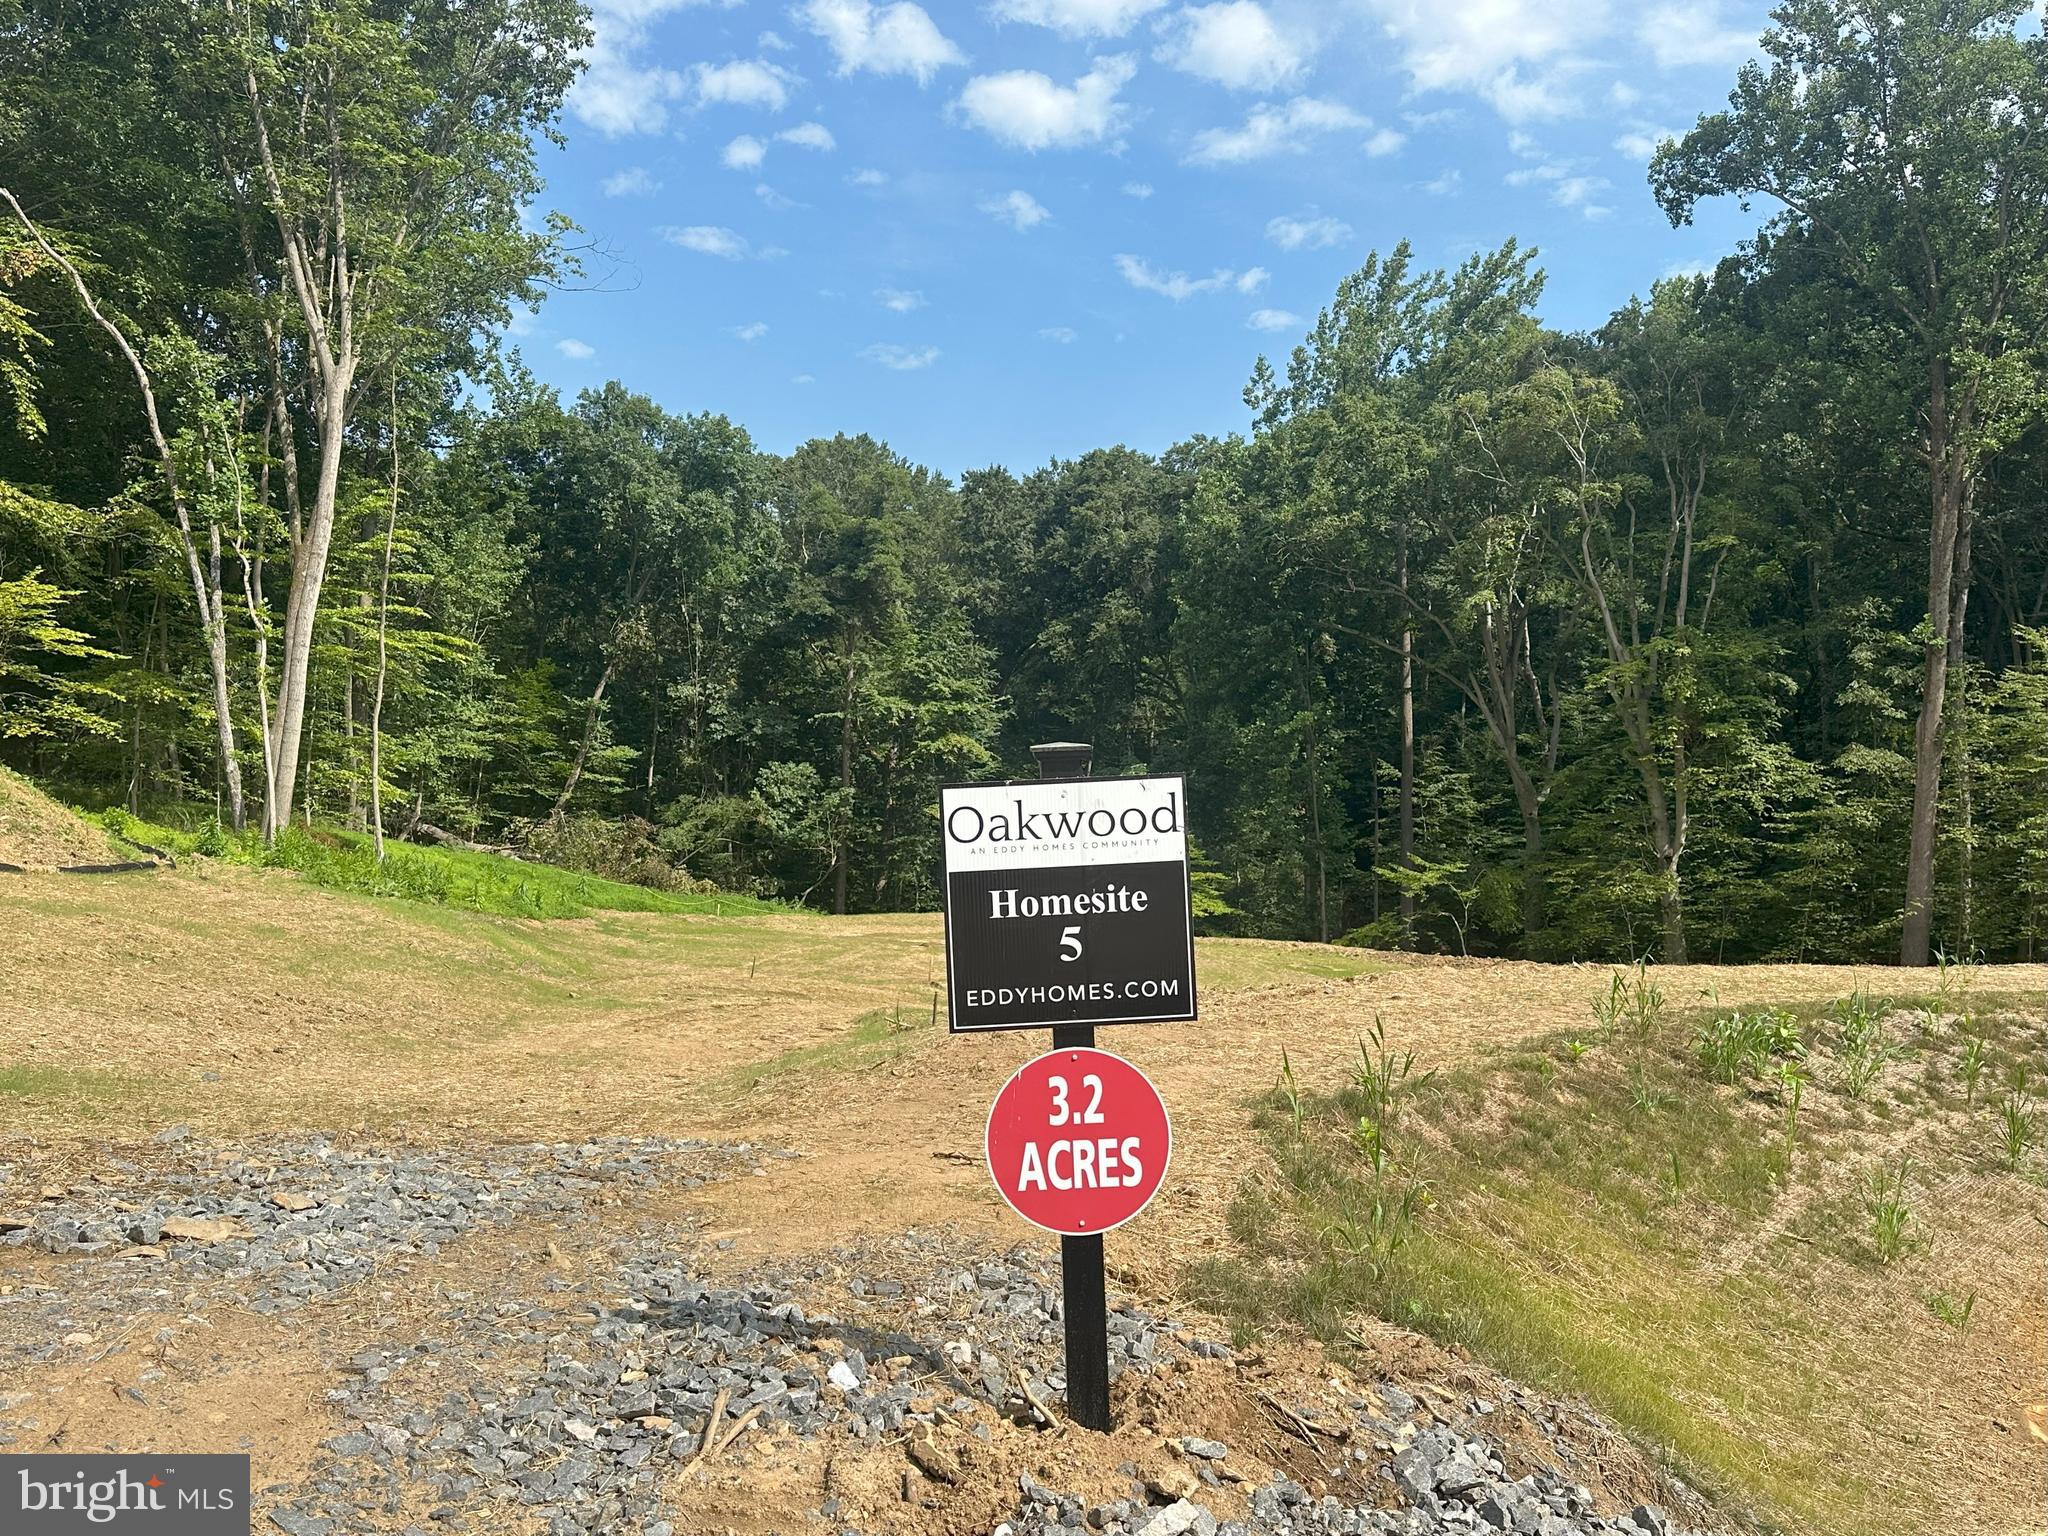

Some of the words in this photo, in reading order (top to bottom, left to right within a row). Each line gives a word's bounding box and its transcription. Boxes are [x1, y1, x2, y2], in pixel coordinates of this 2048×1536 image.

[948, 792, 1182, 844] Oakwood
[970, 847, 986, 855] AN
[993, 845, 1026, 854] EDDY
[1033, 842, 1076, 852] HOMES
[1082, 838, 1160, 849] COMMUNITY
[988, 884, 1149, 919] Homesite
[1059, 925, 1083, 962] 5
[966, 979, 1180, 1007] EDDYHOMES.COM
[1048, 1074, 1105, 1126] 3.2
[1017, 1136, 1143, 1192] ACRES
